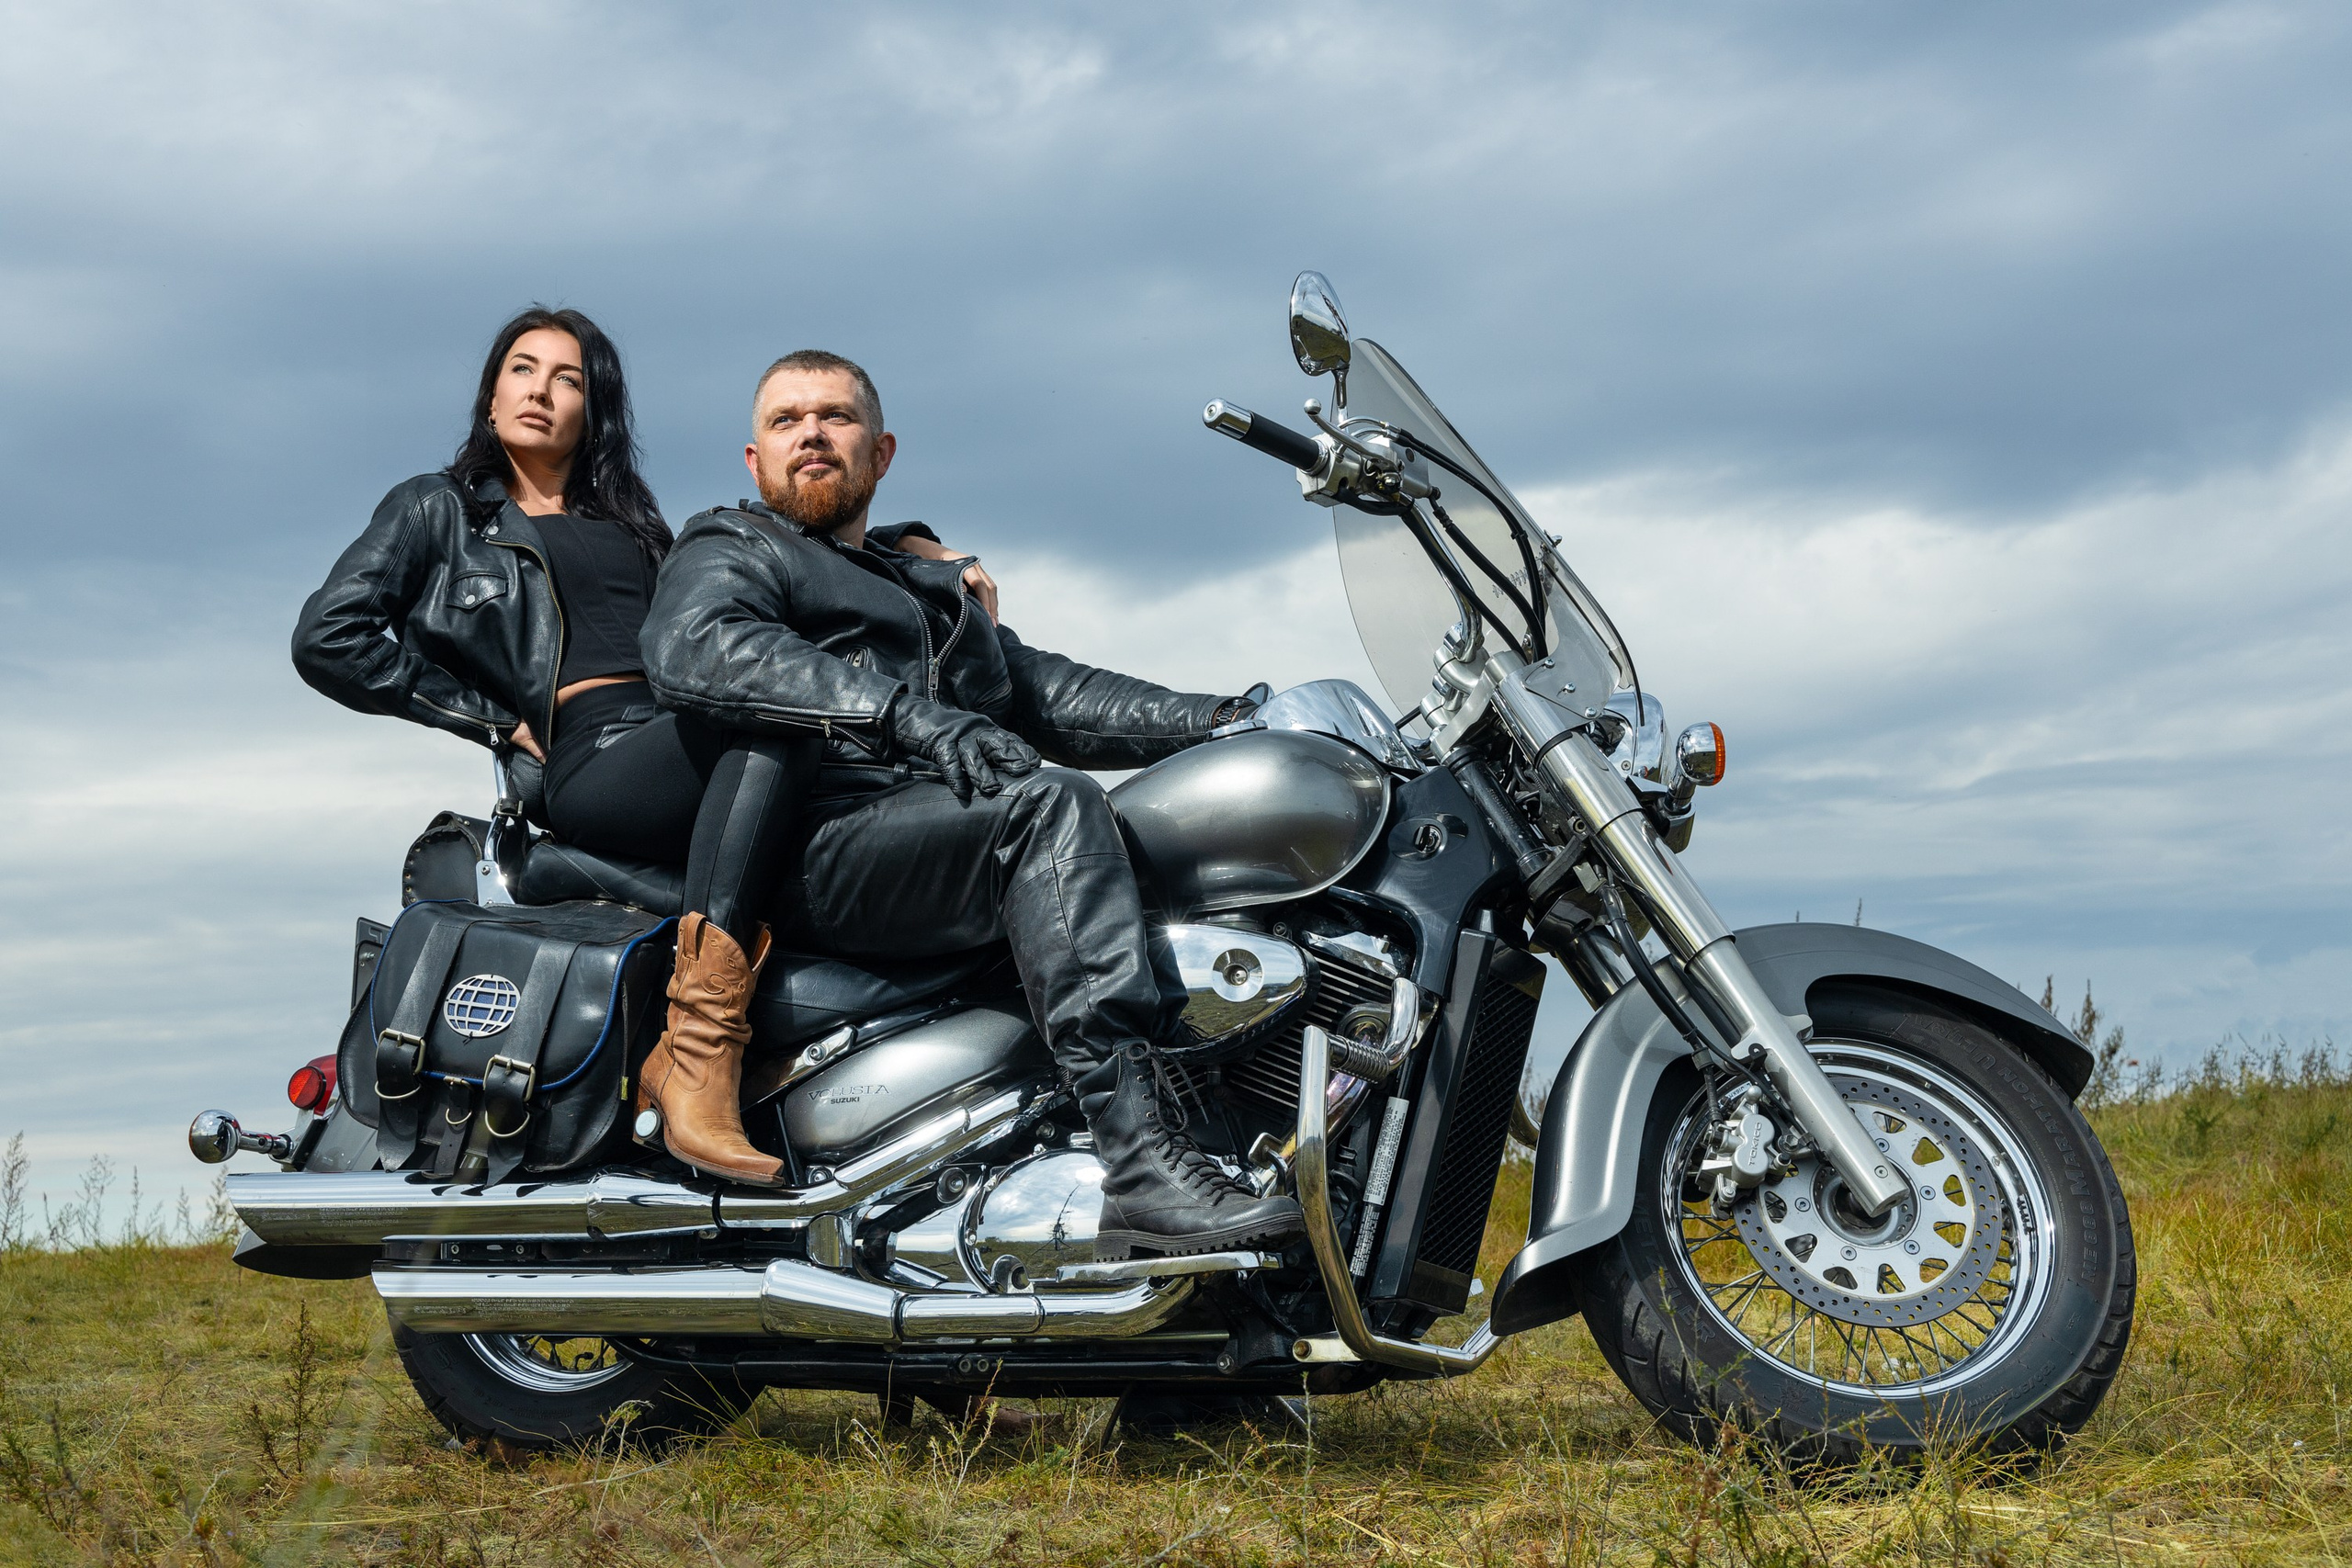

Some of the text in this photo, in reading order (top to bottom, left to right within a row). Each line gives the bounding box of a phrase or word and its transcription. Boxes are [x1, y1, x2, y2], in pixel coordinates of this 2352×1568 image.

[830, 1096, 860, 1105] SUZUKI
[1748, 1122, 1762, 1166] TOKICO
[1996, 1066, 2092, 1196] MARATHON
